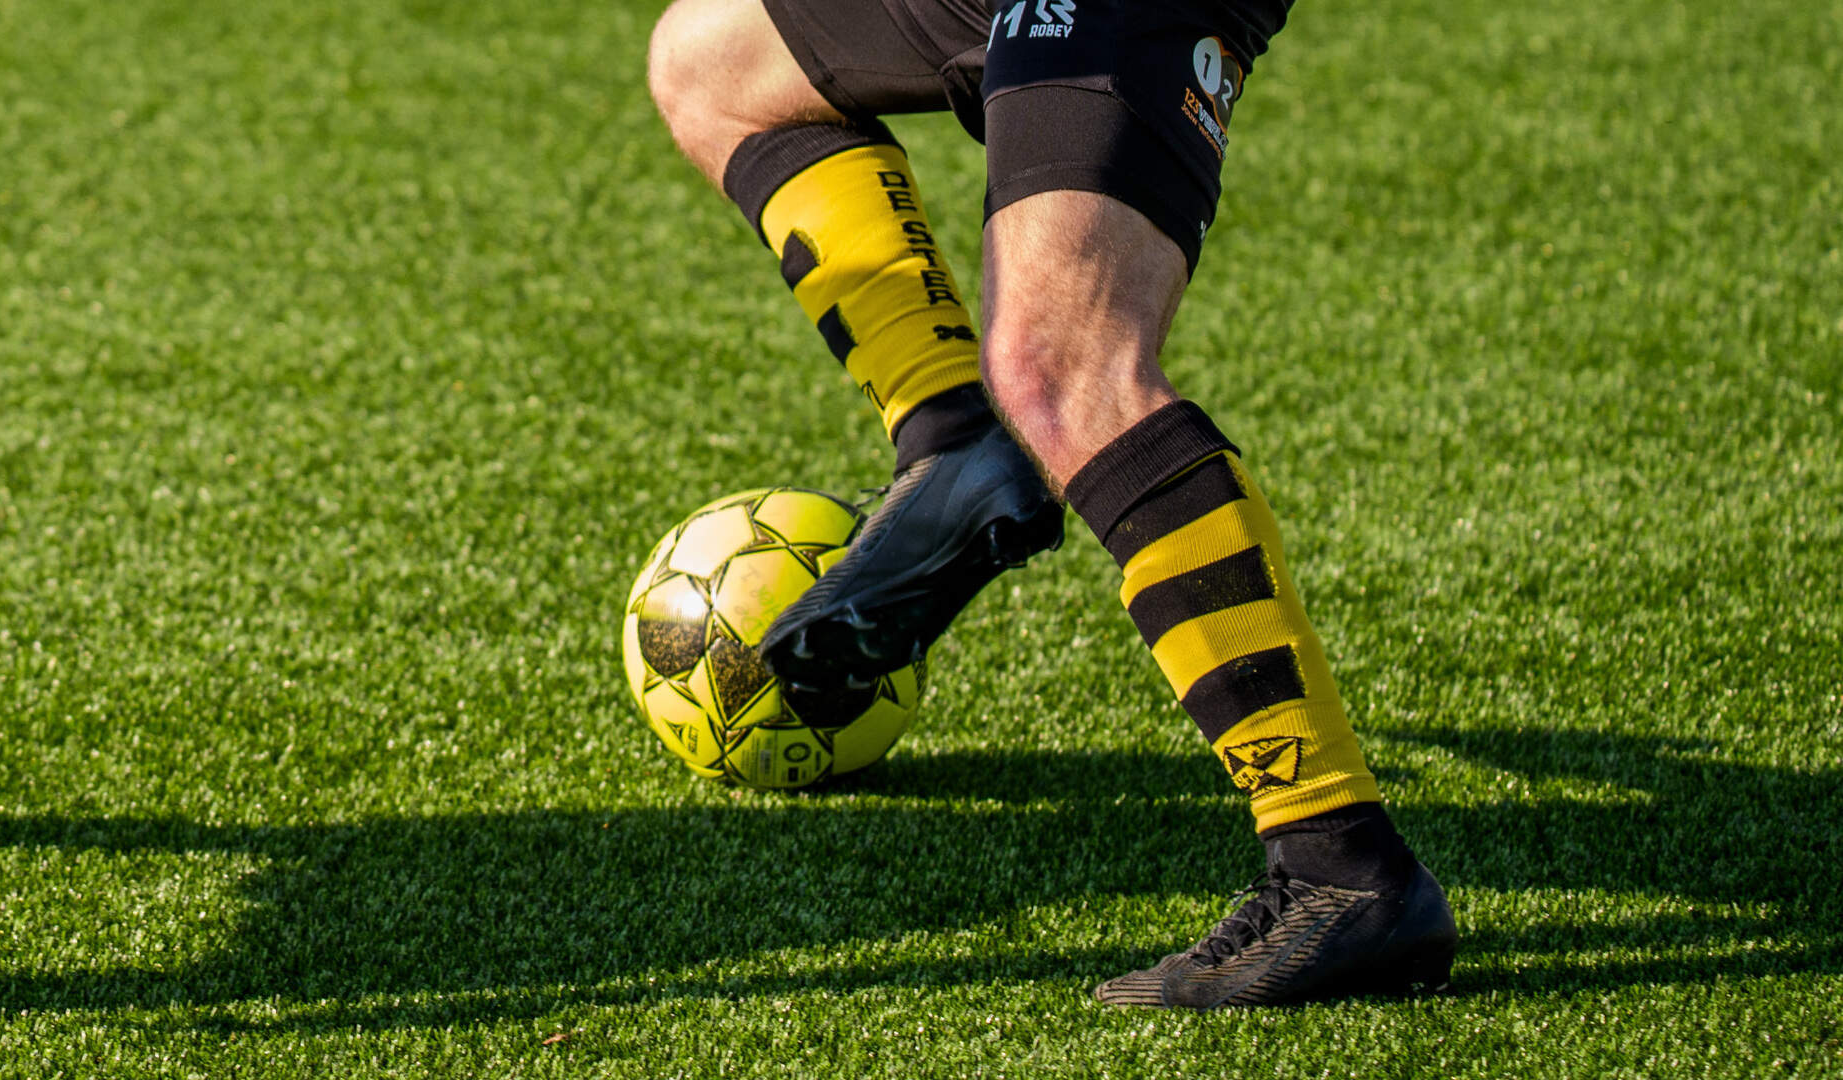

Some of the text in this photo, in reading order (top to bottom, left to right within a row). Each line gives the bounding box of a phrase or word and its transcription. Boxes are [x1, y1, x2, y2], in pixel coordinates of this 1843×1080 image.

[1028, 23, 1074, 38] ROBEY
[876, 170, 961, 307] DE STER
